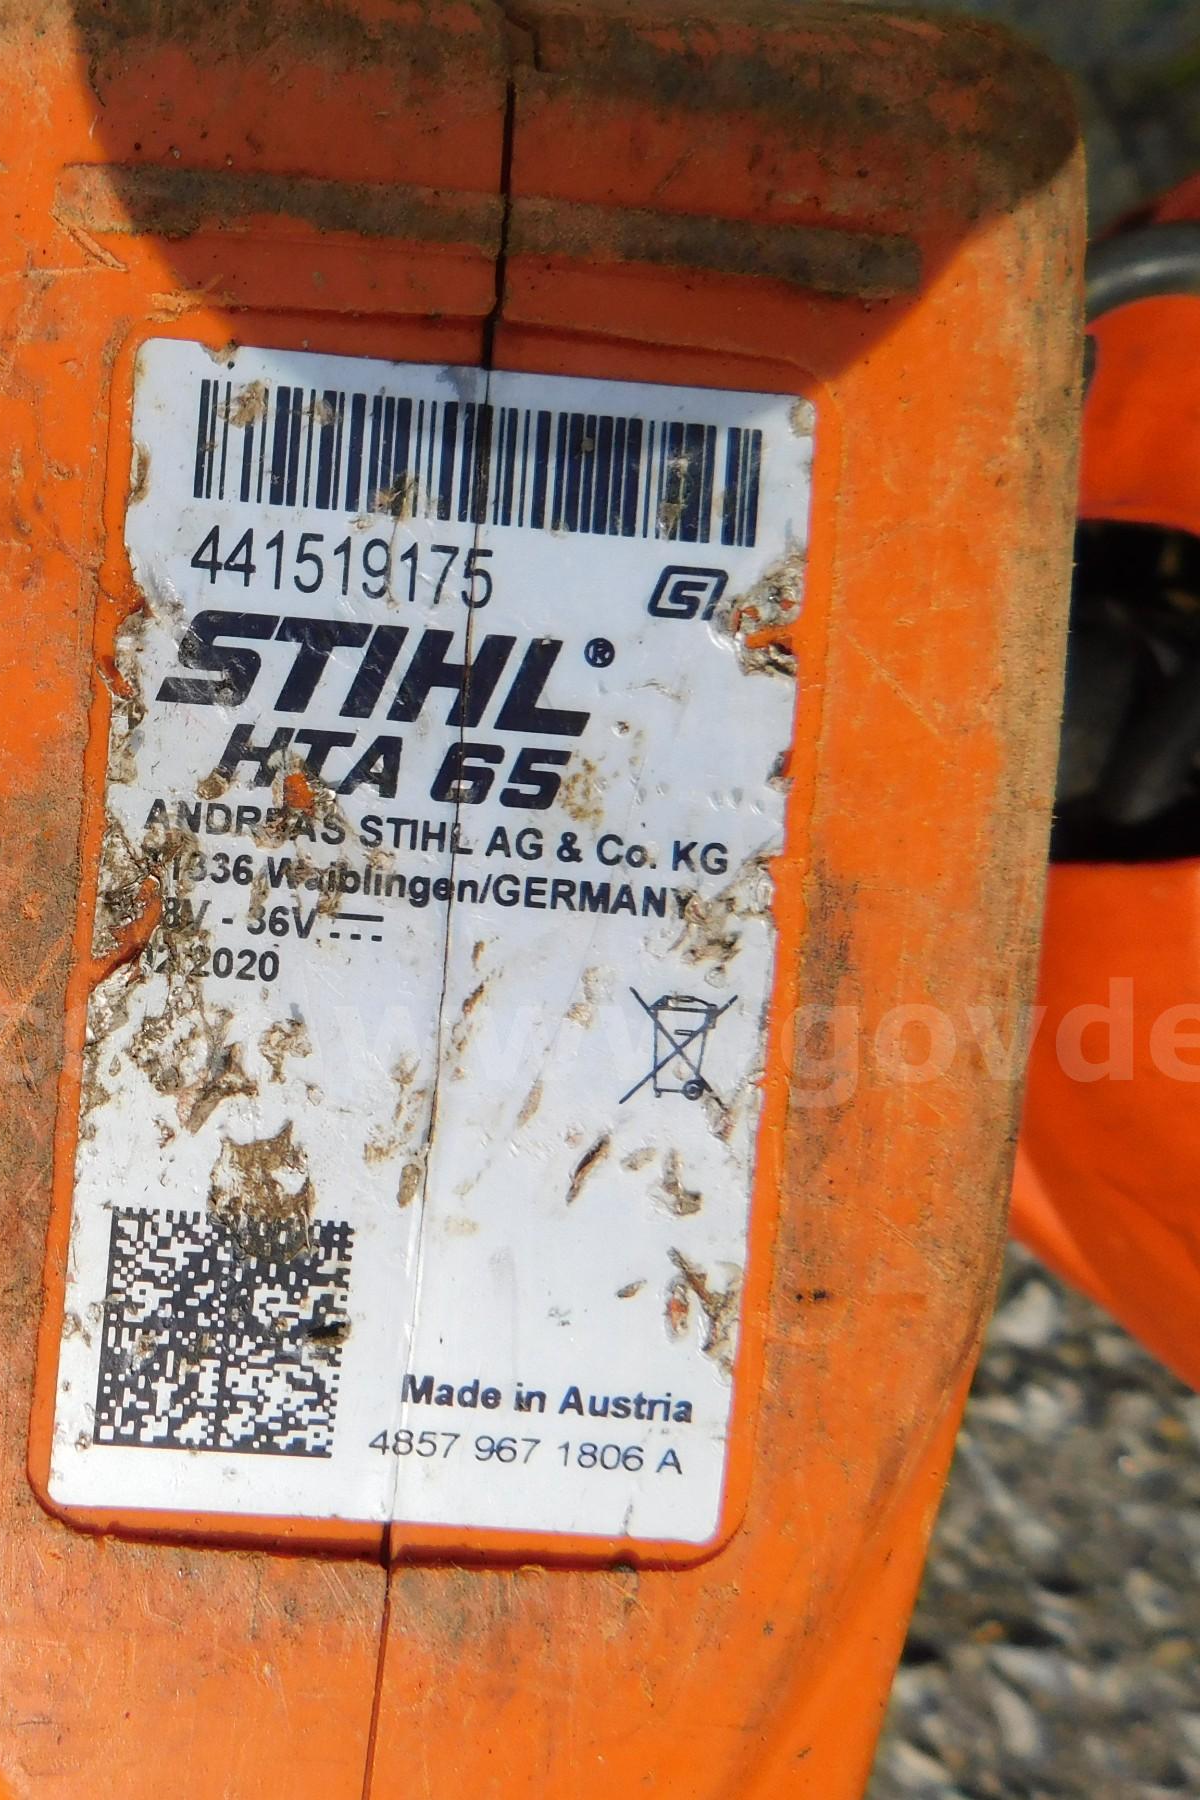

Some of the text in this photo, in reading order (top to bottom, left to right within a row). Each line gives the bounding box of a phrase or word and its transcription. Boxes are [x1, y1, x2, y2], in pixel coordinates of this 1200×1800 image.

[191, 525, 493, 609] 441519175
[212, 723, 572, 810] HTA 65
[360, 814, 473, 855] STIHL
[485, 826, 543, 860] AG
[557, 831, 583, 863] &
[597, 834, 657, 869] Co.
[672, 840, 728, 875] KG
[246, 903, 318, 939] 36V
[401, 1373, 693, 1424] Made in Austria
[368, 1428, 683, 1475] 4857 967 1806 A
